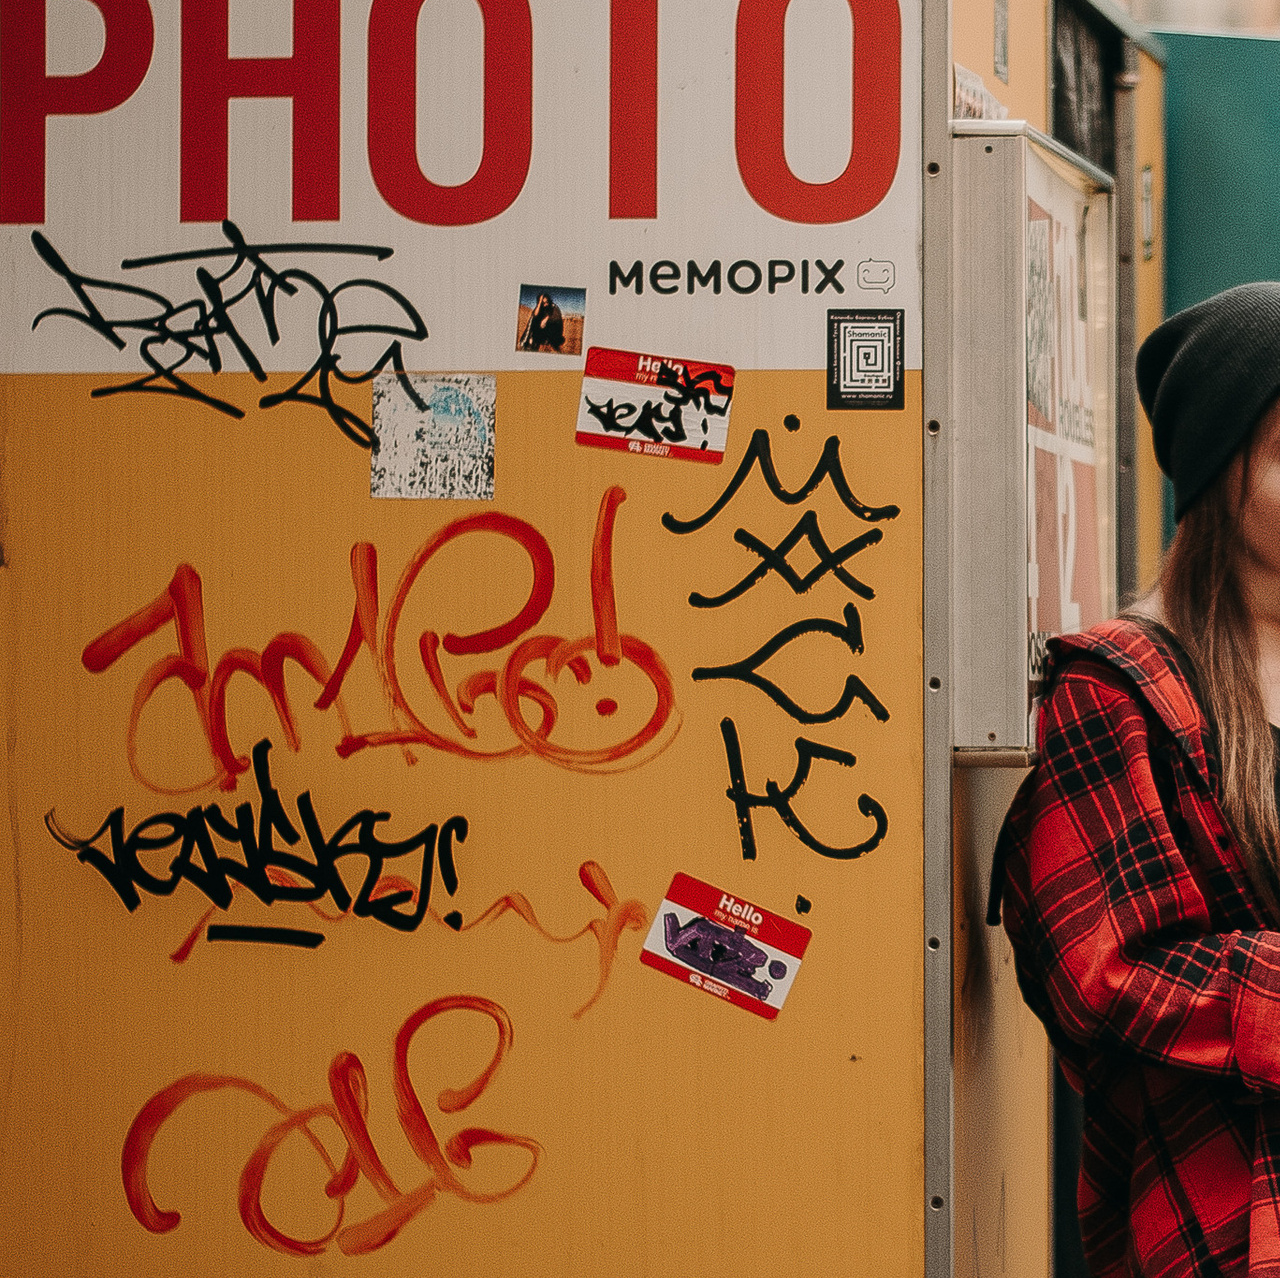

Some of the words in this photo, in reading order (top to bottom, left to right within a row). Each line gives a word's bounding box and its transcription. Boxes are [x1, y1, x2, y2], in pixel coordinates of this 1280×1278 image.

[847, 330, 888, 338] Shamanic
[714, 909, 728, 922] my
[728, 914, 751, 931] name
[750, 924, 759, 934] is
[718, 893, 764, 925] Hello
